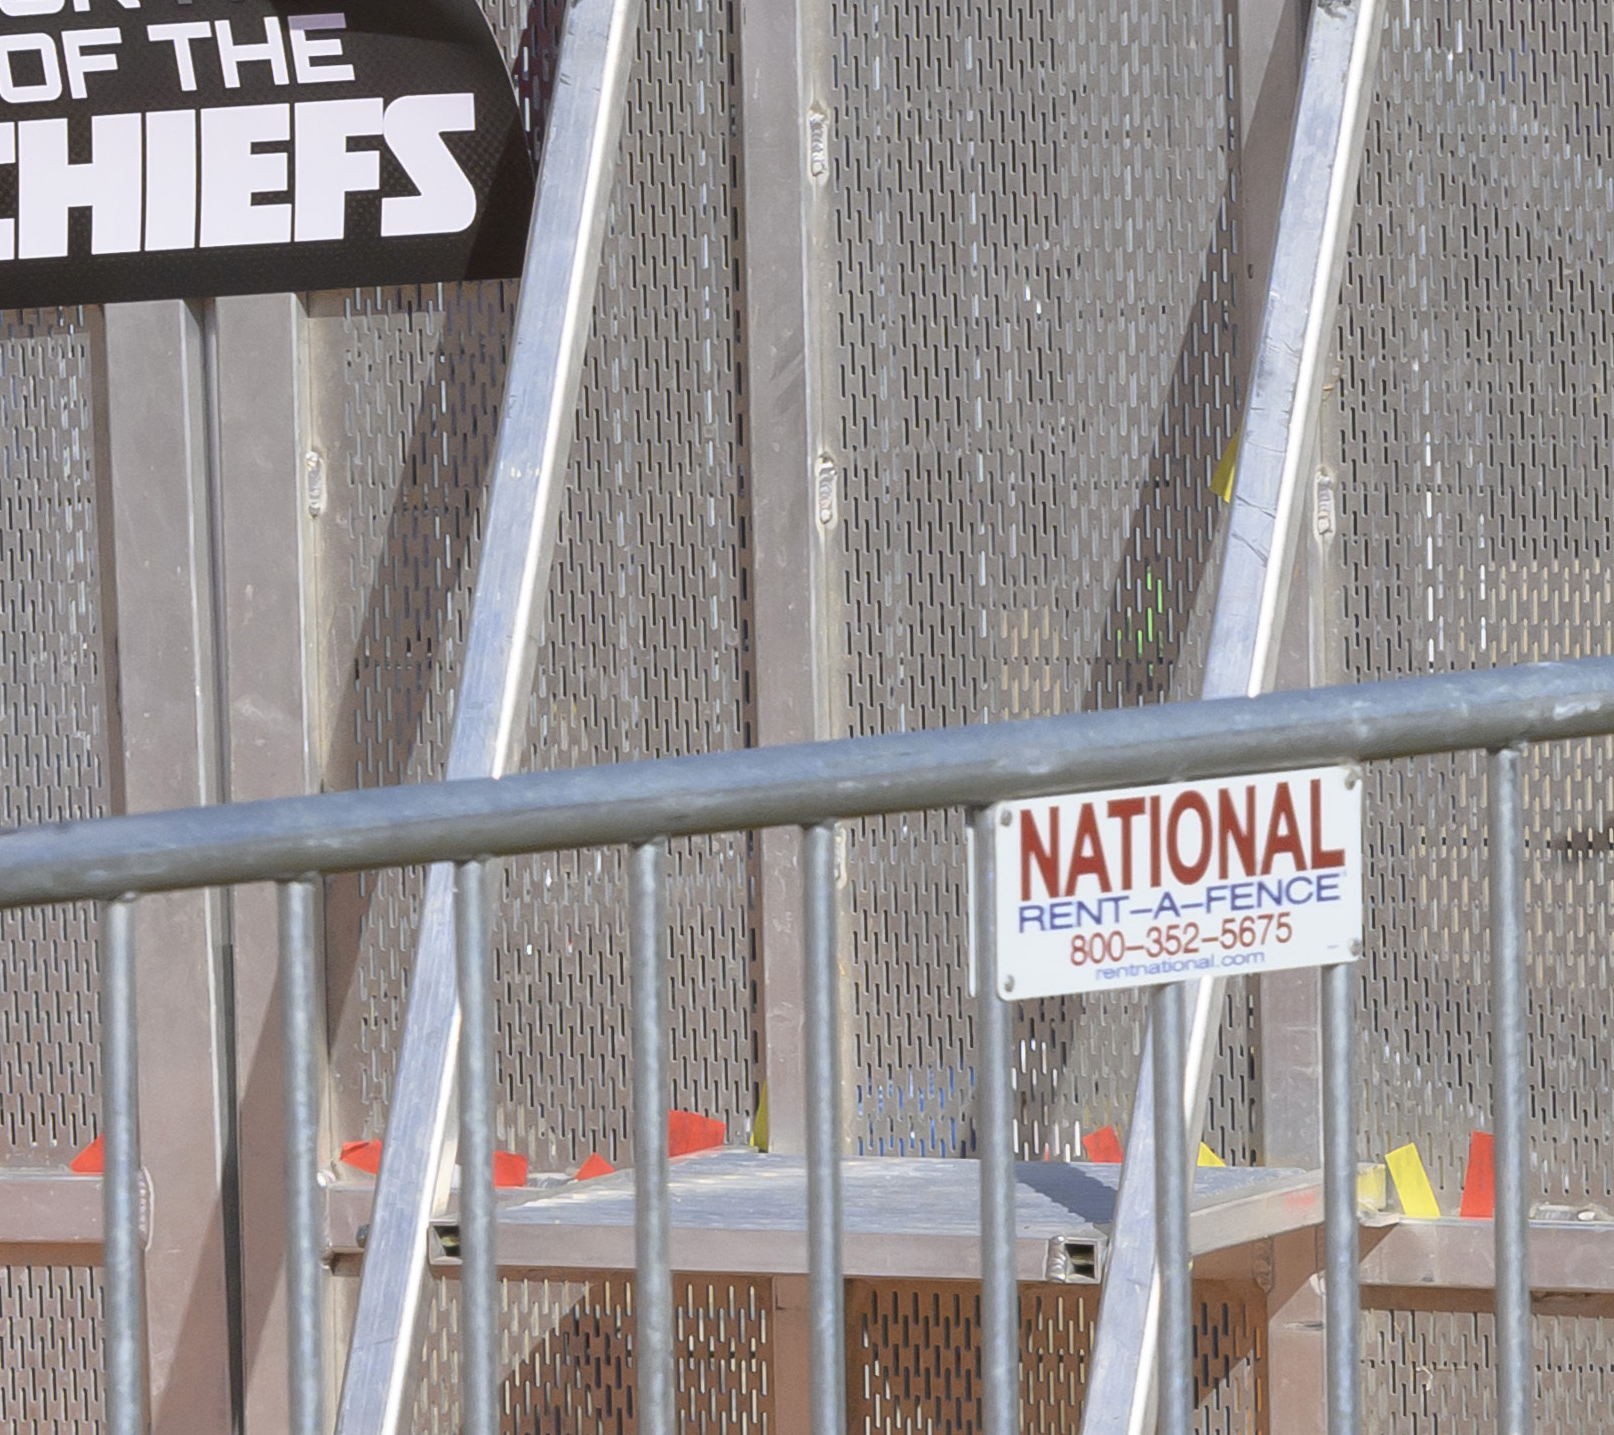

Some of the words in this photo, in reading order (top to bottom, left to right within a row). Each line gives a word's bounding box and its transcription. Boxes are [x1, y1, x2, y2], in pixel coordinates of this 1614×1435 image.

[147, 12, 357, 92] THE
[1019, 779, 1346, 902] NATIONAL
[1018, 872, 1341, 934] RENT-A-FENCE
[1070, 912, 1294, 967] 800-352-5675
[1095, 949, 1266, 982] rentnational.com
